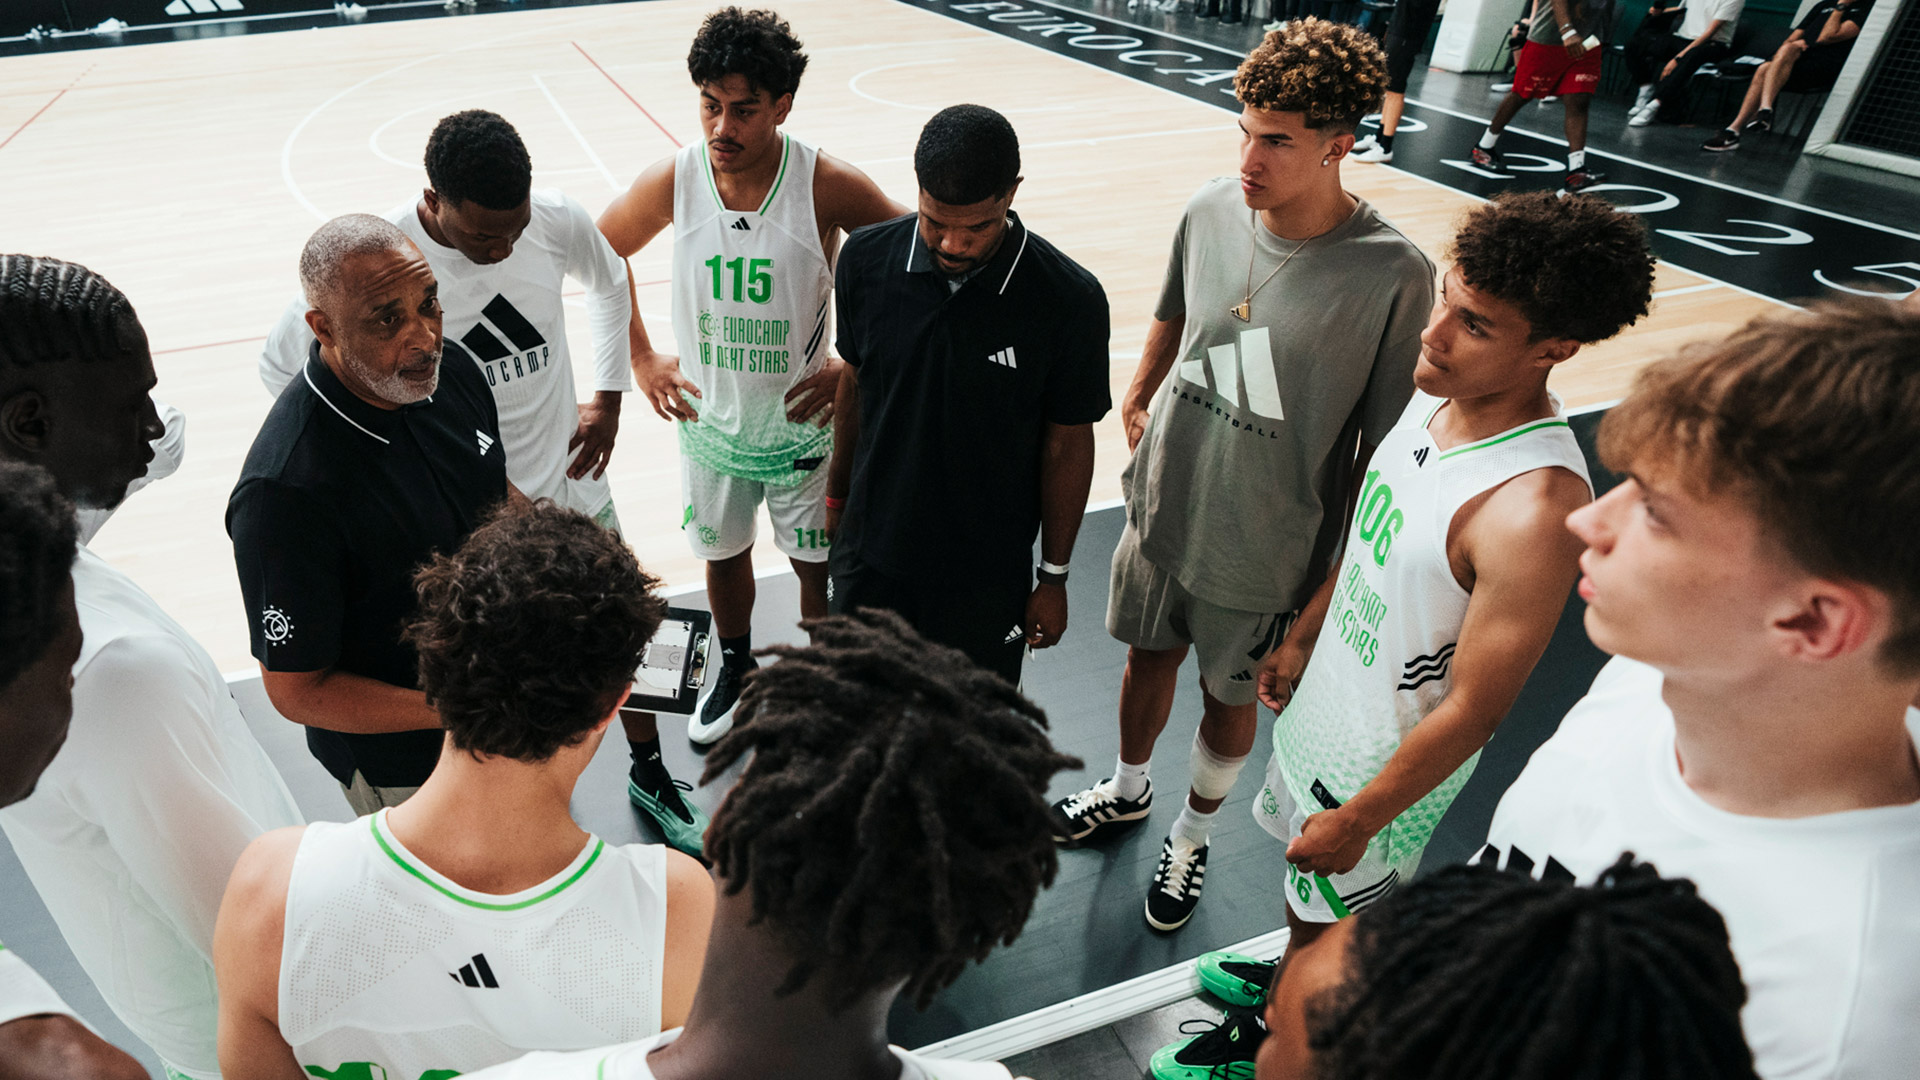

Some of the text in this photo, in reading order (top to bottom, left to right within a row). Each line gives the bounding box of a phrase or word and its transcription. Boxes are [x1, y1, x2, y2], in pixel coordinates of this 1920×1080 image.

[705, 254, 774, 305] 115
[723, 316, 790, 346] EUROCAMP
[485, 346, 549, 387] OCAMP
[717, 345, 745, 372] NEXT
[749, 349, 789, 374] STARS
[1172, 386, 1278, 439] BASKETBALL
[1356, 469, 1404, 570] 106
[1288, 863, 1313, 906] 06
